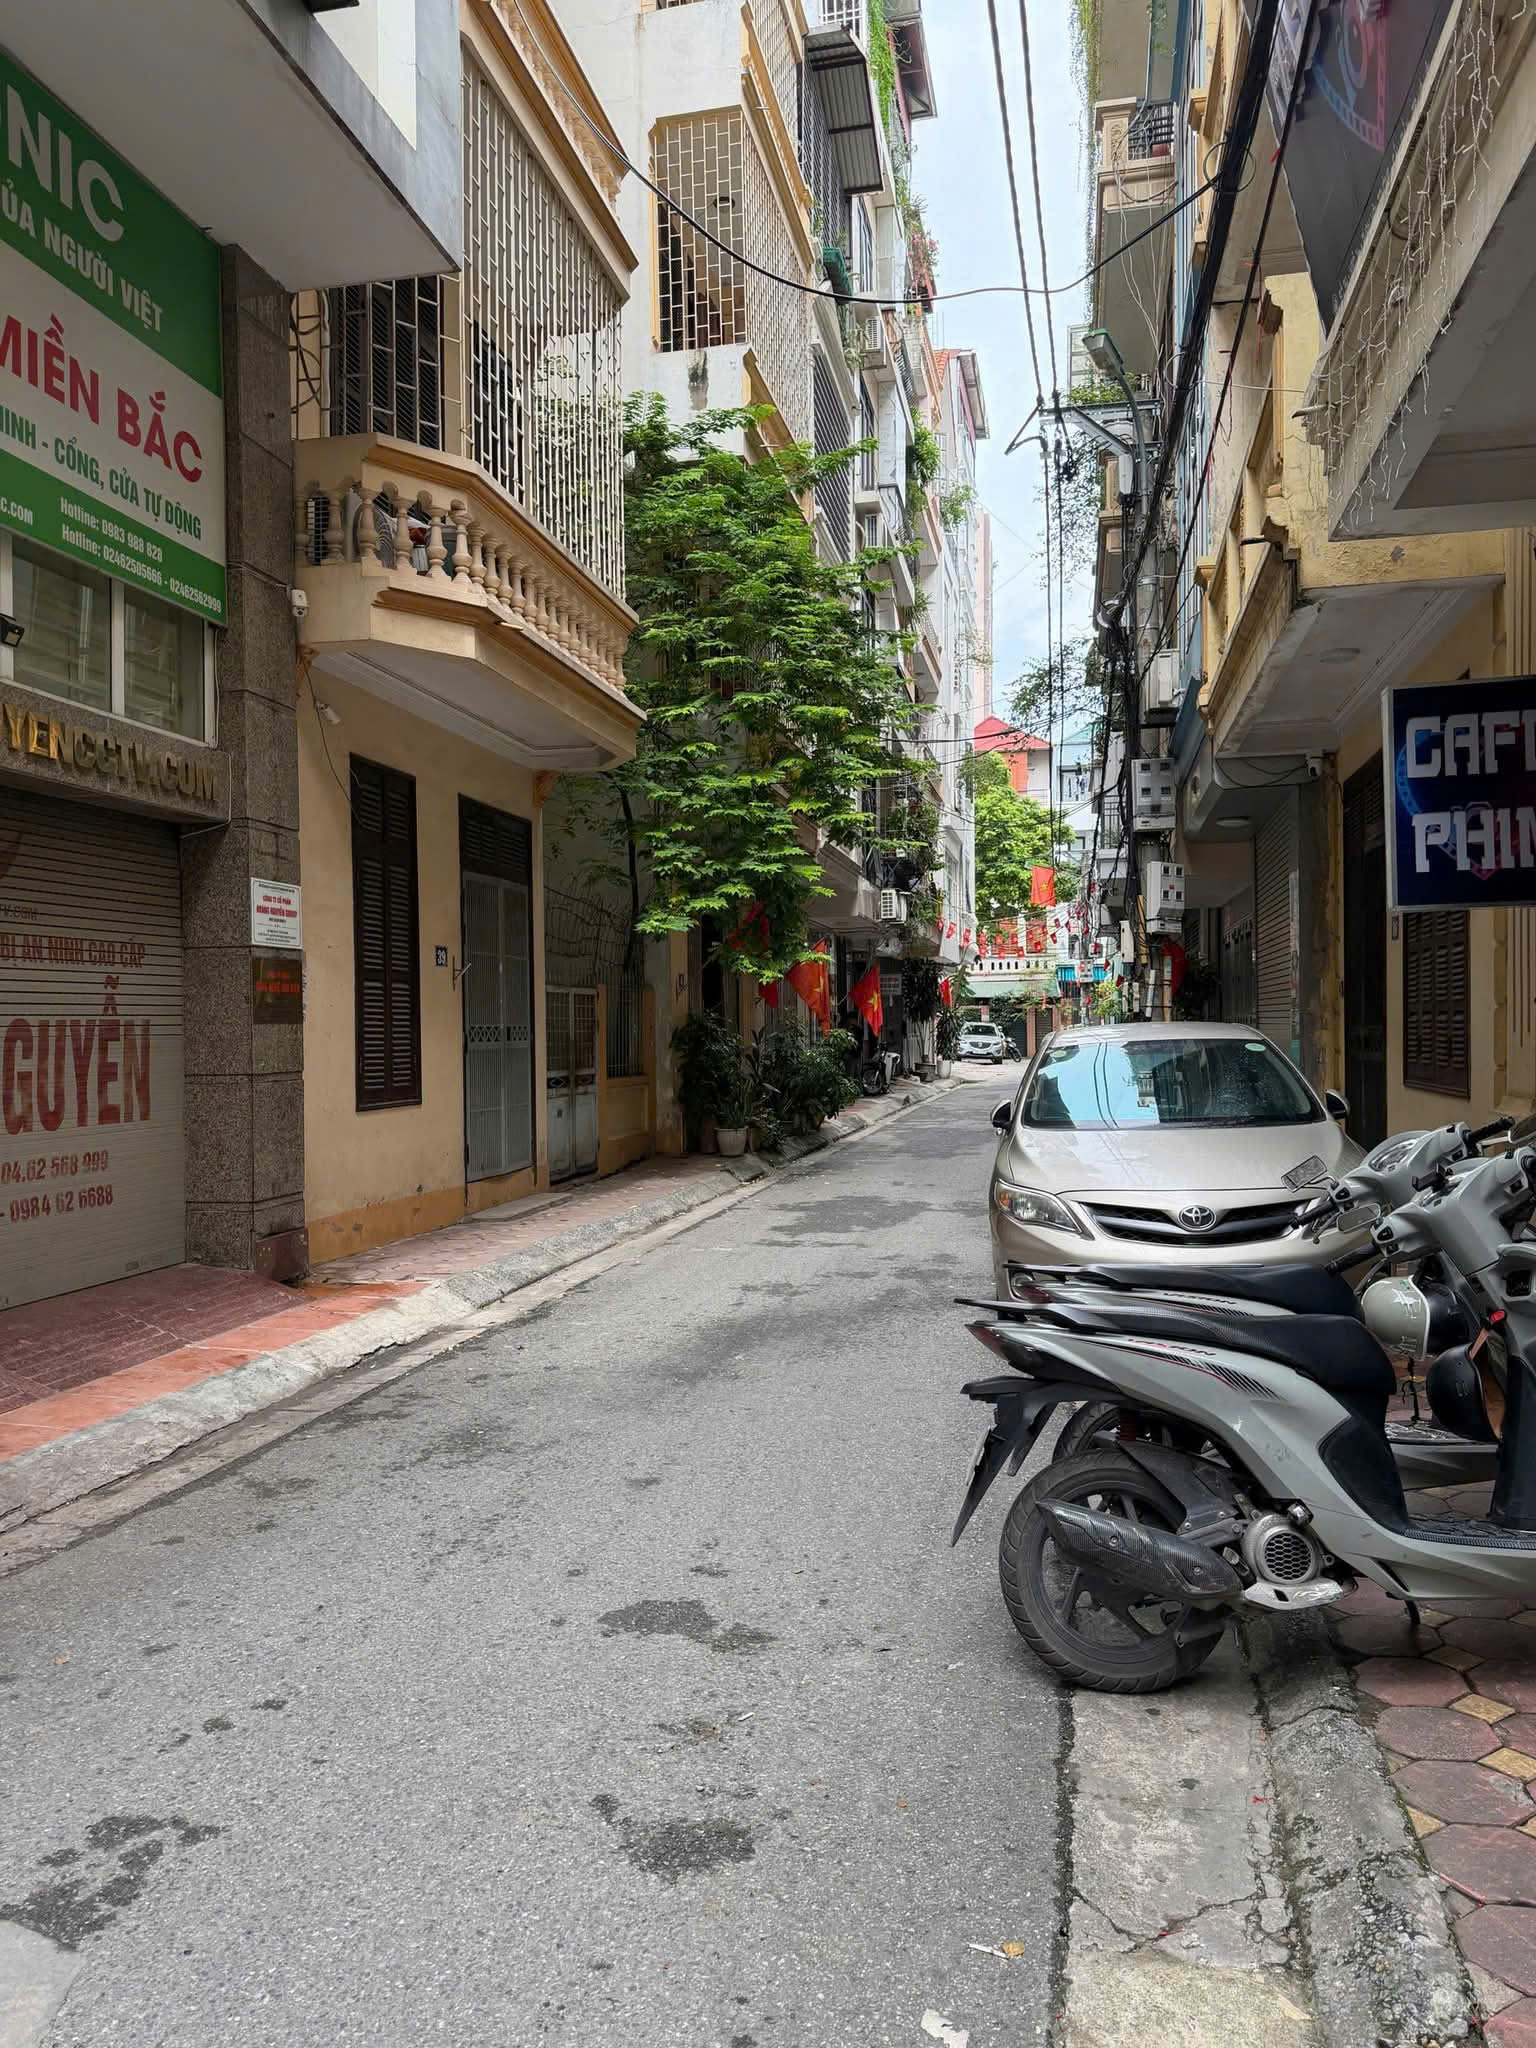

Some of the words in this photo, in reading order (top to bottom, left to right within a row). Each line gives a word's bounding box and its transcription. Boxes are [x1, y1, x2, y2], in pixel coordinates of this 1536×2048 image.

[44, 217, 114, 297] NGƯỜI
[120, 277, 163, 333] VIỆT
[117, 387, 203, 483] BẮC
[0, 404, 36, 450] INH
[54, 436, 104, 490] CỔNG,
[109, 466, 139, 506] CỬA
[144, 488, 162, 523] TỰ
[165, 503, 202, 540] ĐỘNG
[61, 497, 99, 530] Hotline:
[102, 517, 126, 544] 0983
[62, 524, 101, 558] Hotline:
[88, 941, 115, 967] CAO
[120, 935, 145, 968] CẤP
[437, 949, 446, 965] 39
